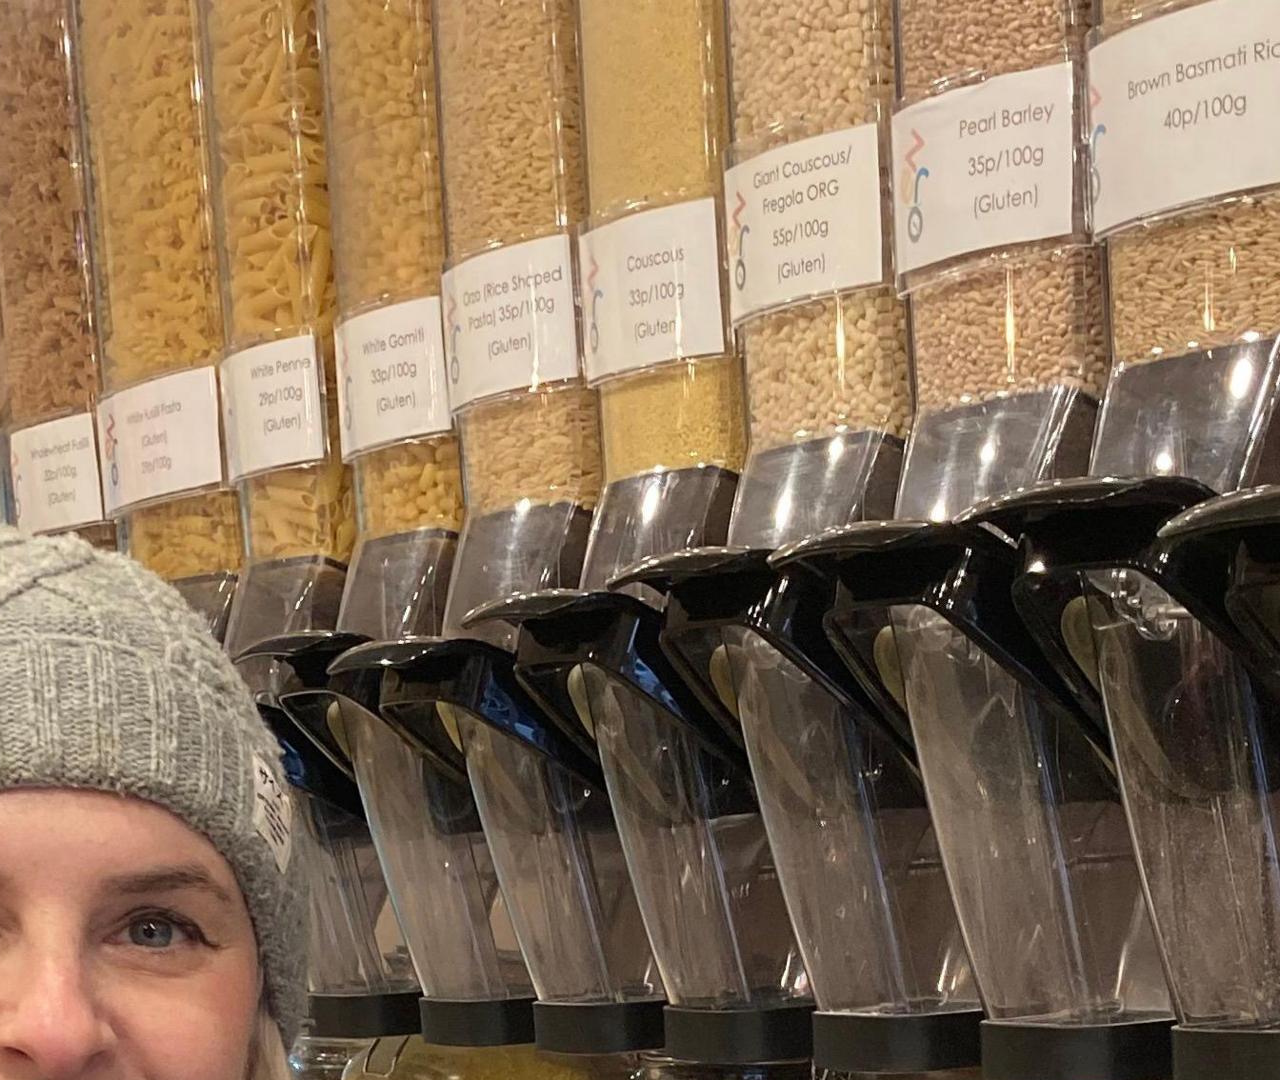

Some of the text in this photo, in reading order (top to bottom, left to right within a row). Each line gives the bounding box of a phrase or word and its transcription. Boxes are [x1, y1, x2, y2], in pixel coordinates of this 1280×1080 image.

[1127, 71, 1170, 100] Brown
[1175, 43, 1248, 83] Basmati
[959, 103, 1055, 140] Pearl Barley
[1163, 93, 1247, 130] 40p/100g
[753, 145, 853, 190] Giant Couscous/
[968, 145, 1044, 177] 35p/100g
[762, 177, 840, 215] Fregola ORG
[972, 184, 1038, 219] (Gluten)
[772, 218, 829, 248] 55p/100g
[626, 248, 685, 273] Couscous
[777, 252, 826, 281] (Gluten)
[483, 279, 510, 303] (Rice
[511, 264, 563, 292] Shaped
[628, 281, 685, 307] 33p/100g
[498, 296, 554, 323] 35p/100g
[488, 332, 531, 361] (Gluten)
[275, 356, 311, 373] Penne
[370, 362, 417, 385] 33p/100g
[376, 391, 416, 415] (Gluten)
[263, 415, 301, 435] (Gluten)
